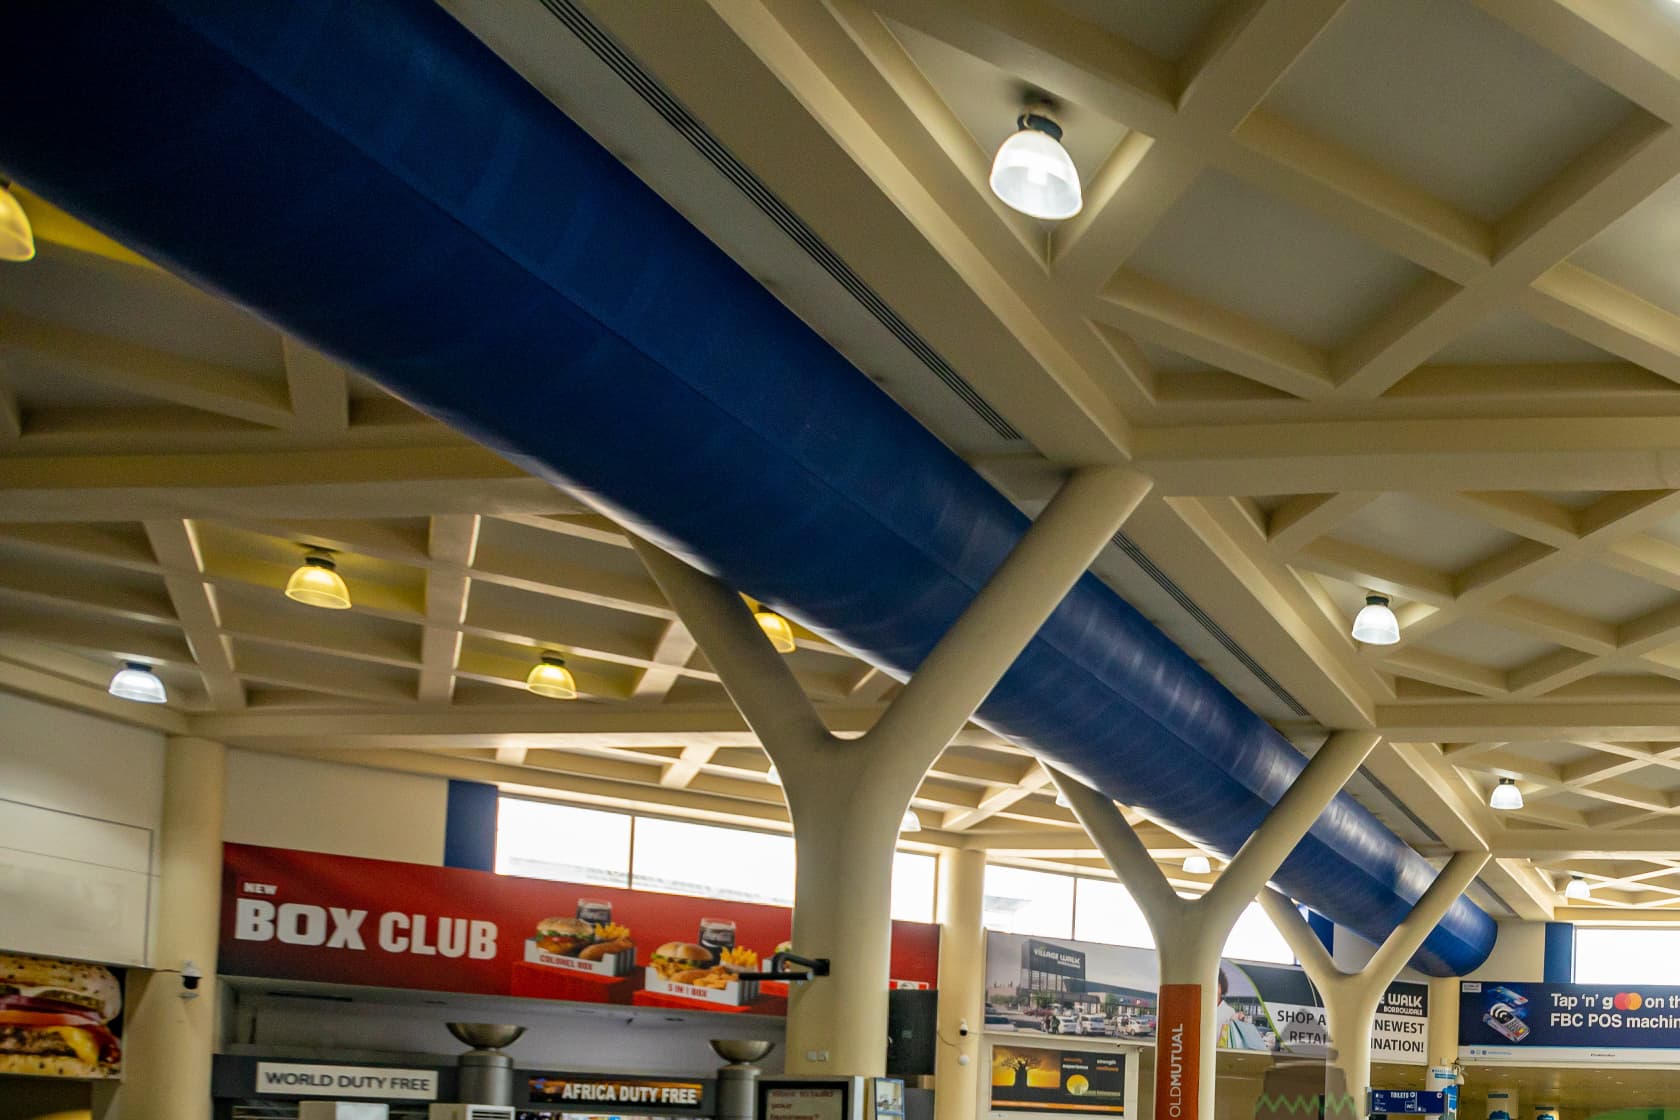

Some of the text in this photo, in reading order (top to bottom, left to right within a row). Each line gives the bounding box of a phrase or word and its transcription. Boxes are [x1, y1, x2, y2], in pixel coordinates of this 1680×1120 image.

[244, 882, 277, 895] NEW
[235, 898, 497, 960] BOX CLUB
[1388, 993, 1423, 1007] WALK
[1550, 992, 1578, 1011] Tap
[1645, 996, 1660, 1008] on
[1277, 1010, 1327, 1025] SHOP A
[1550, 1012, 1583, 1027] FBC
[1588, 1013, 1622, 1028] POS
[1374, 1019, 1425, 1035] NEWEST
[1289, 1031, 1327, 1044] RETAI
[1371, 1037, 1425, 1053] INATION!
[1169, 1023, 1184, 1118] OLDMUTUAL
[265, 1072, 431, 1091] WORLD DUTY FREE
[561, 1083, 698, 1104] AFRICA DUTY FREE
